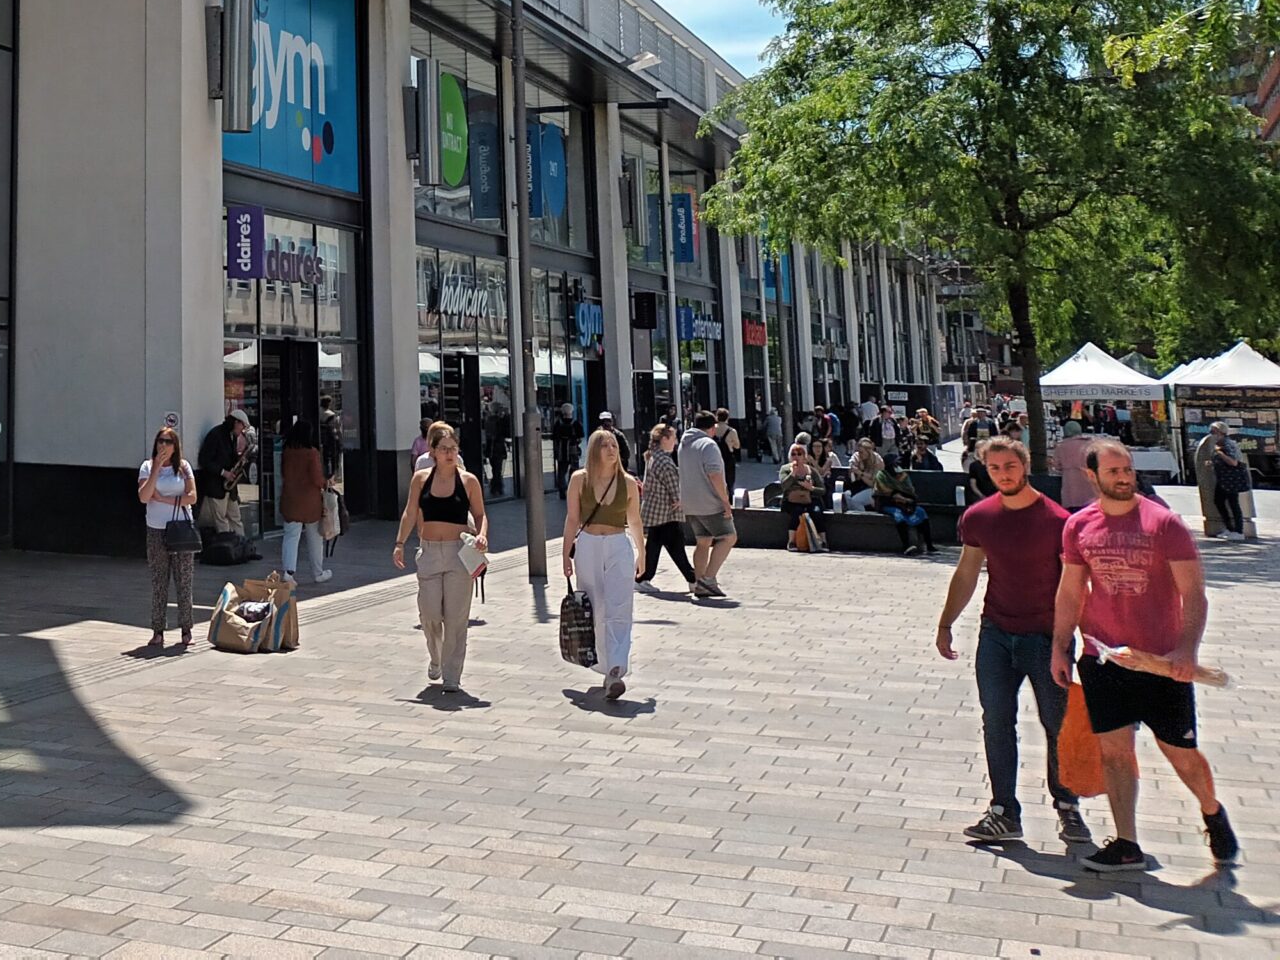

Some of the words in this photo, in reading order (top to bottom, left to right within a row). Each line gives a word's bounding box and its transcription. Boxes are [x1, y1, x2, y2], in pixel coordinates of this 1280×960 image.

[237, 213, 251, 271] claire's
[440, 273, 488, 328] bodycare
[1043, 388, 1099, 397] SHEFFIELD
[1101, 388, 1151, 397] MARKETS
